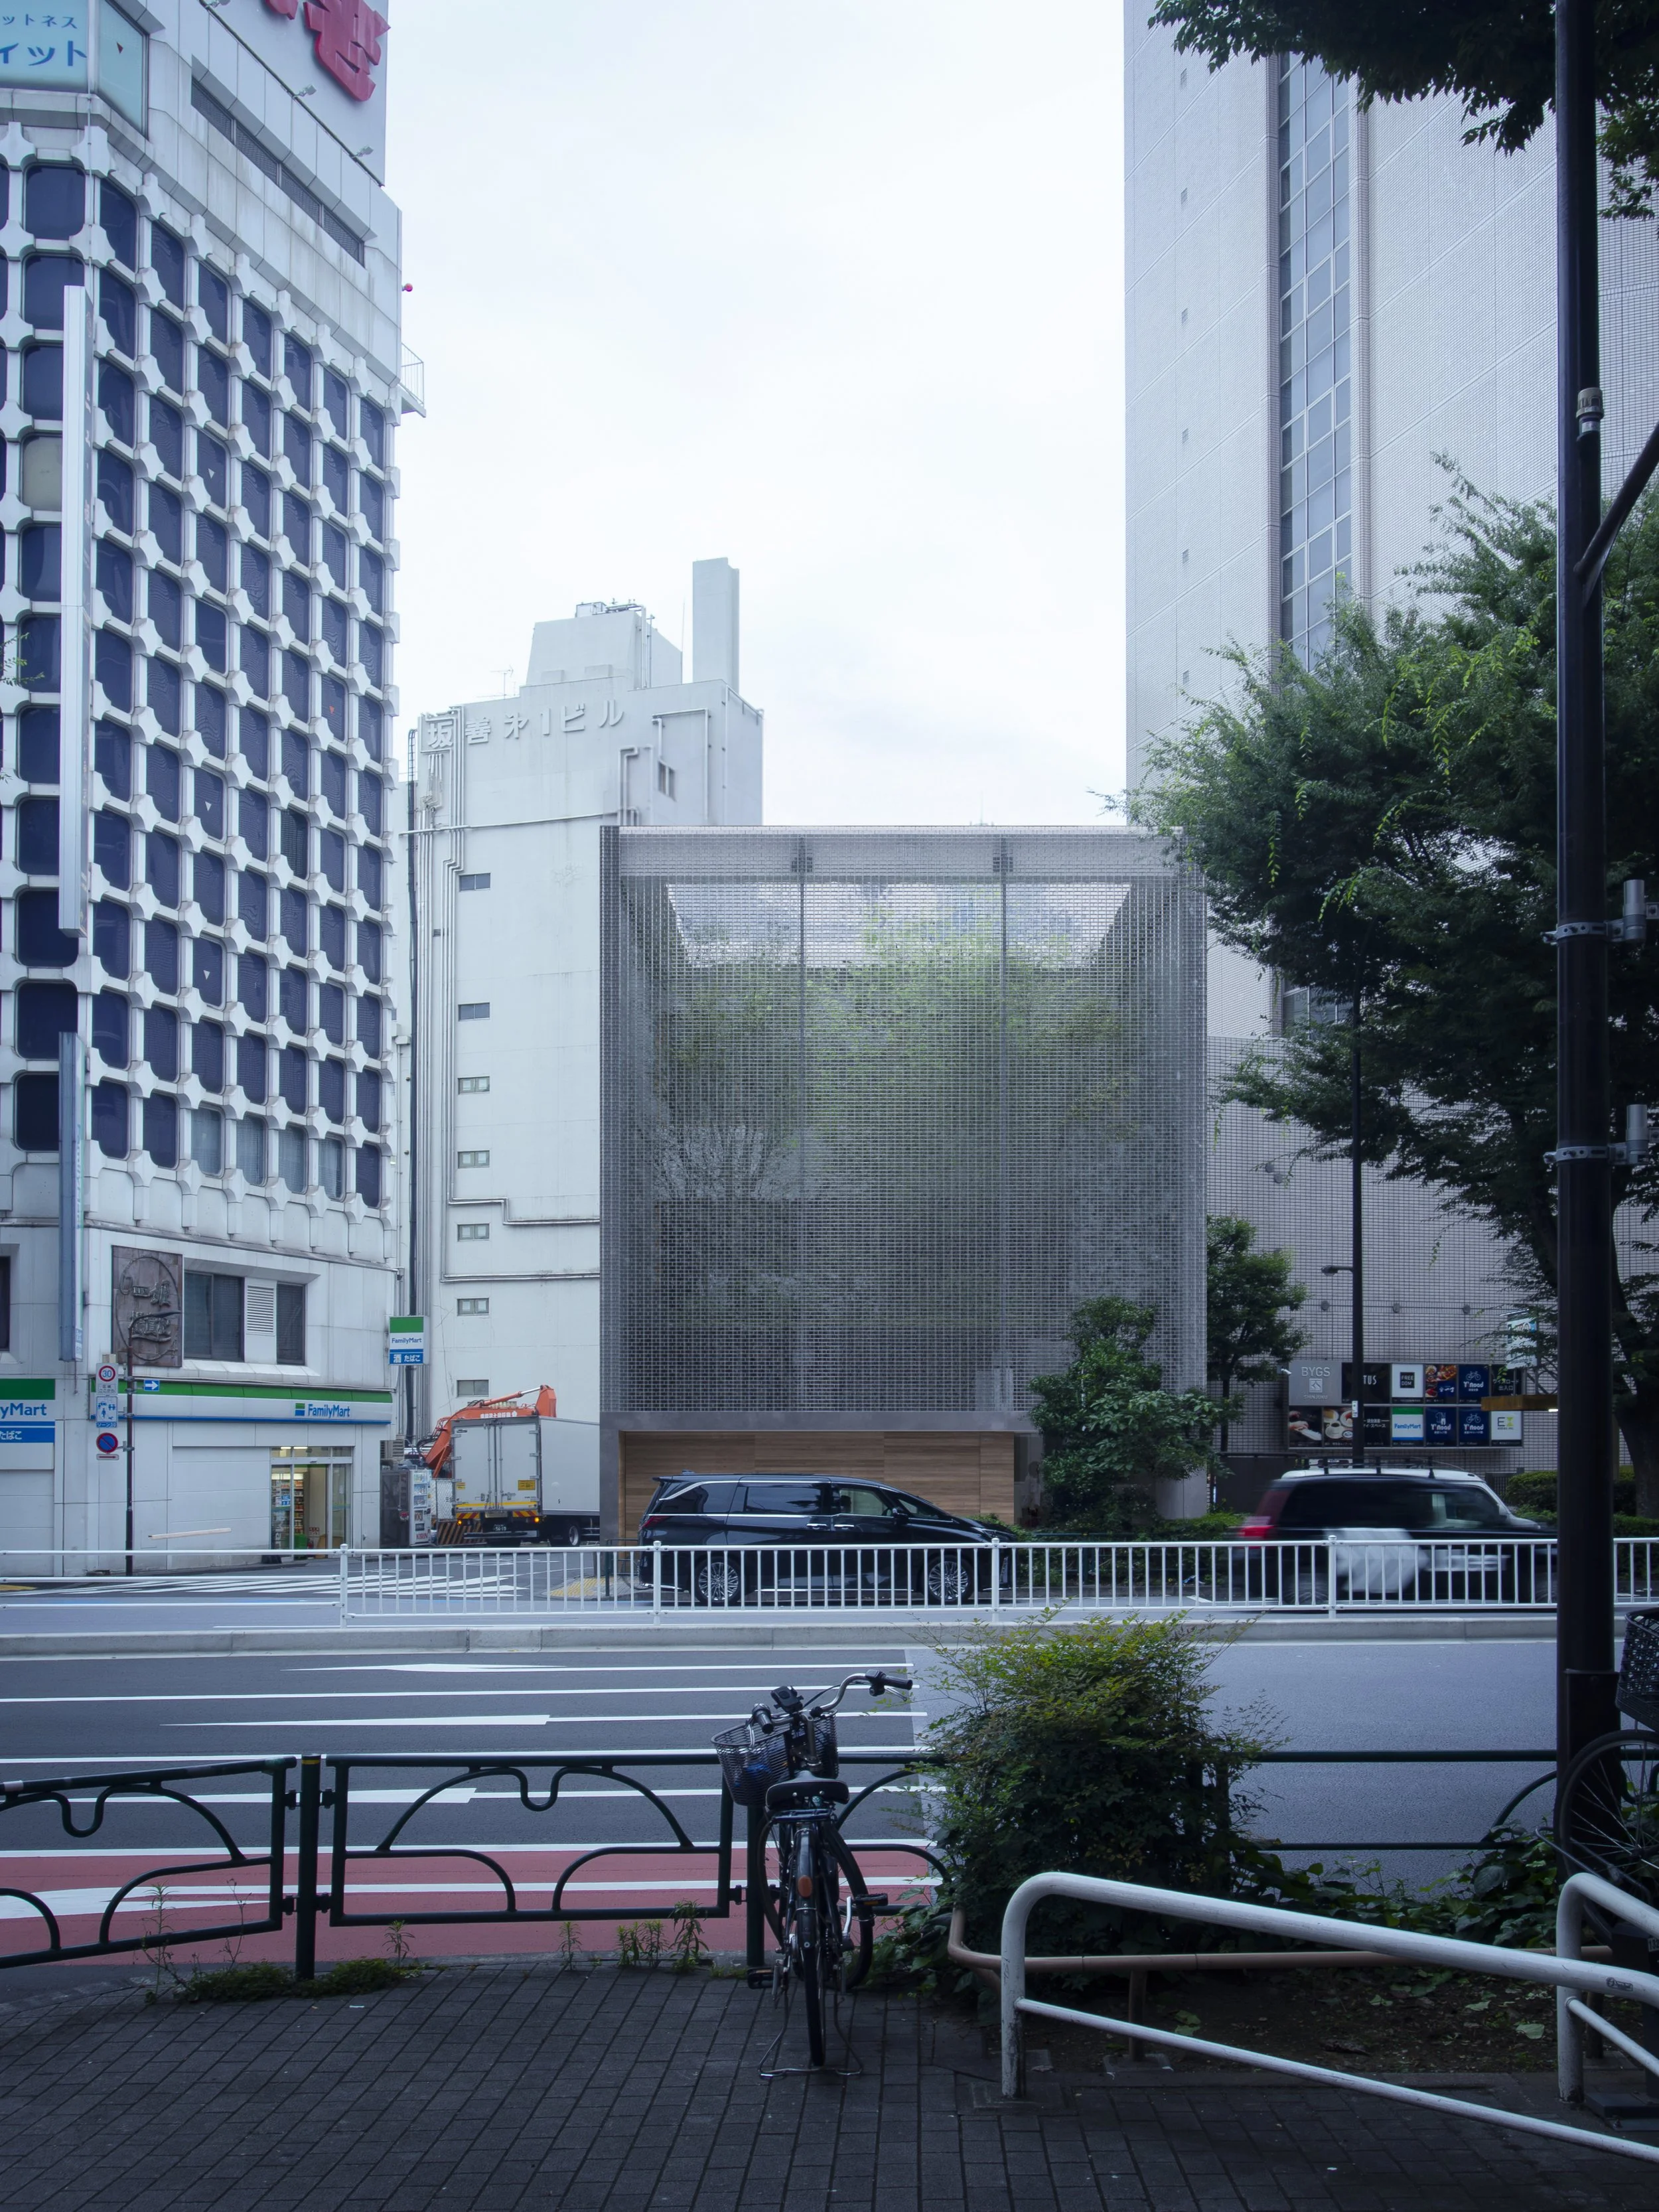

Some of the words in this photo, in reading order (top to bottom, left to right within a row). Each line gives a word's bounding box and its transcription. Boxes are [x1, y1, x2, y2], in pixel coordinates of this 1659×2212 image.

[393, 1354, 402, 1363] 酒
[1301, 1366, 1331, 1377] BYGS
[0, 1402, 48, 1419] yMart
[308, 1403, 350, 1418] FamilyMart
